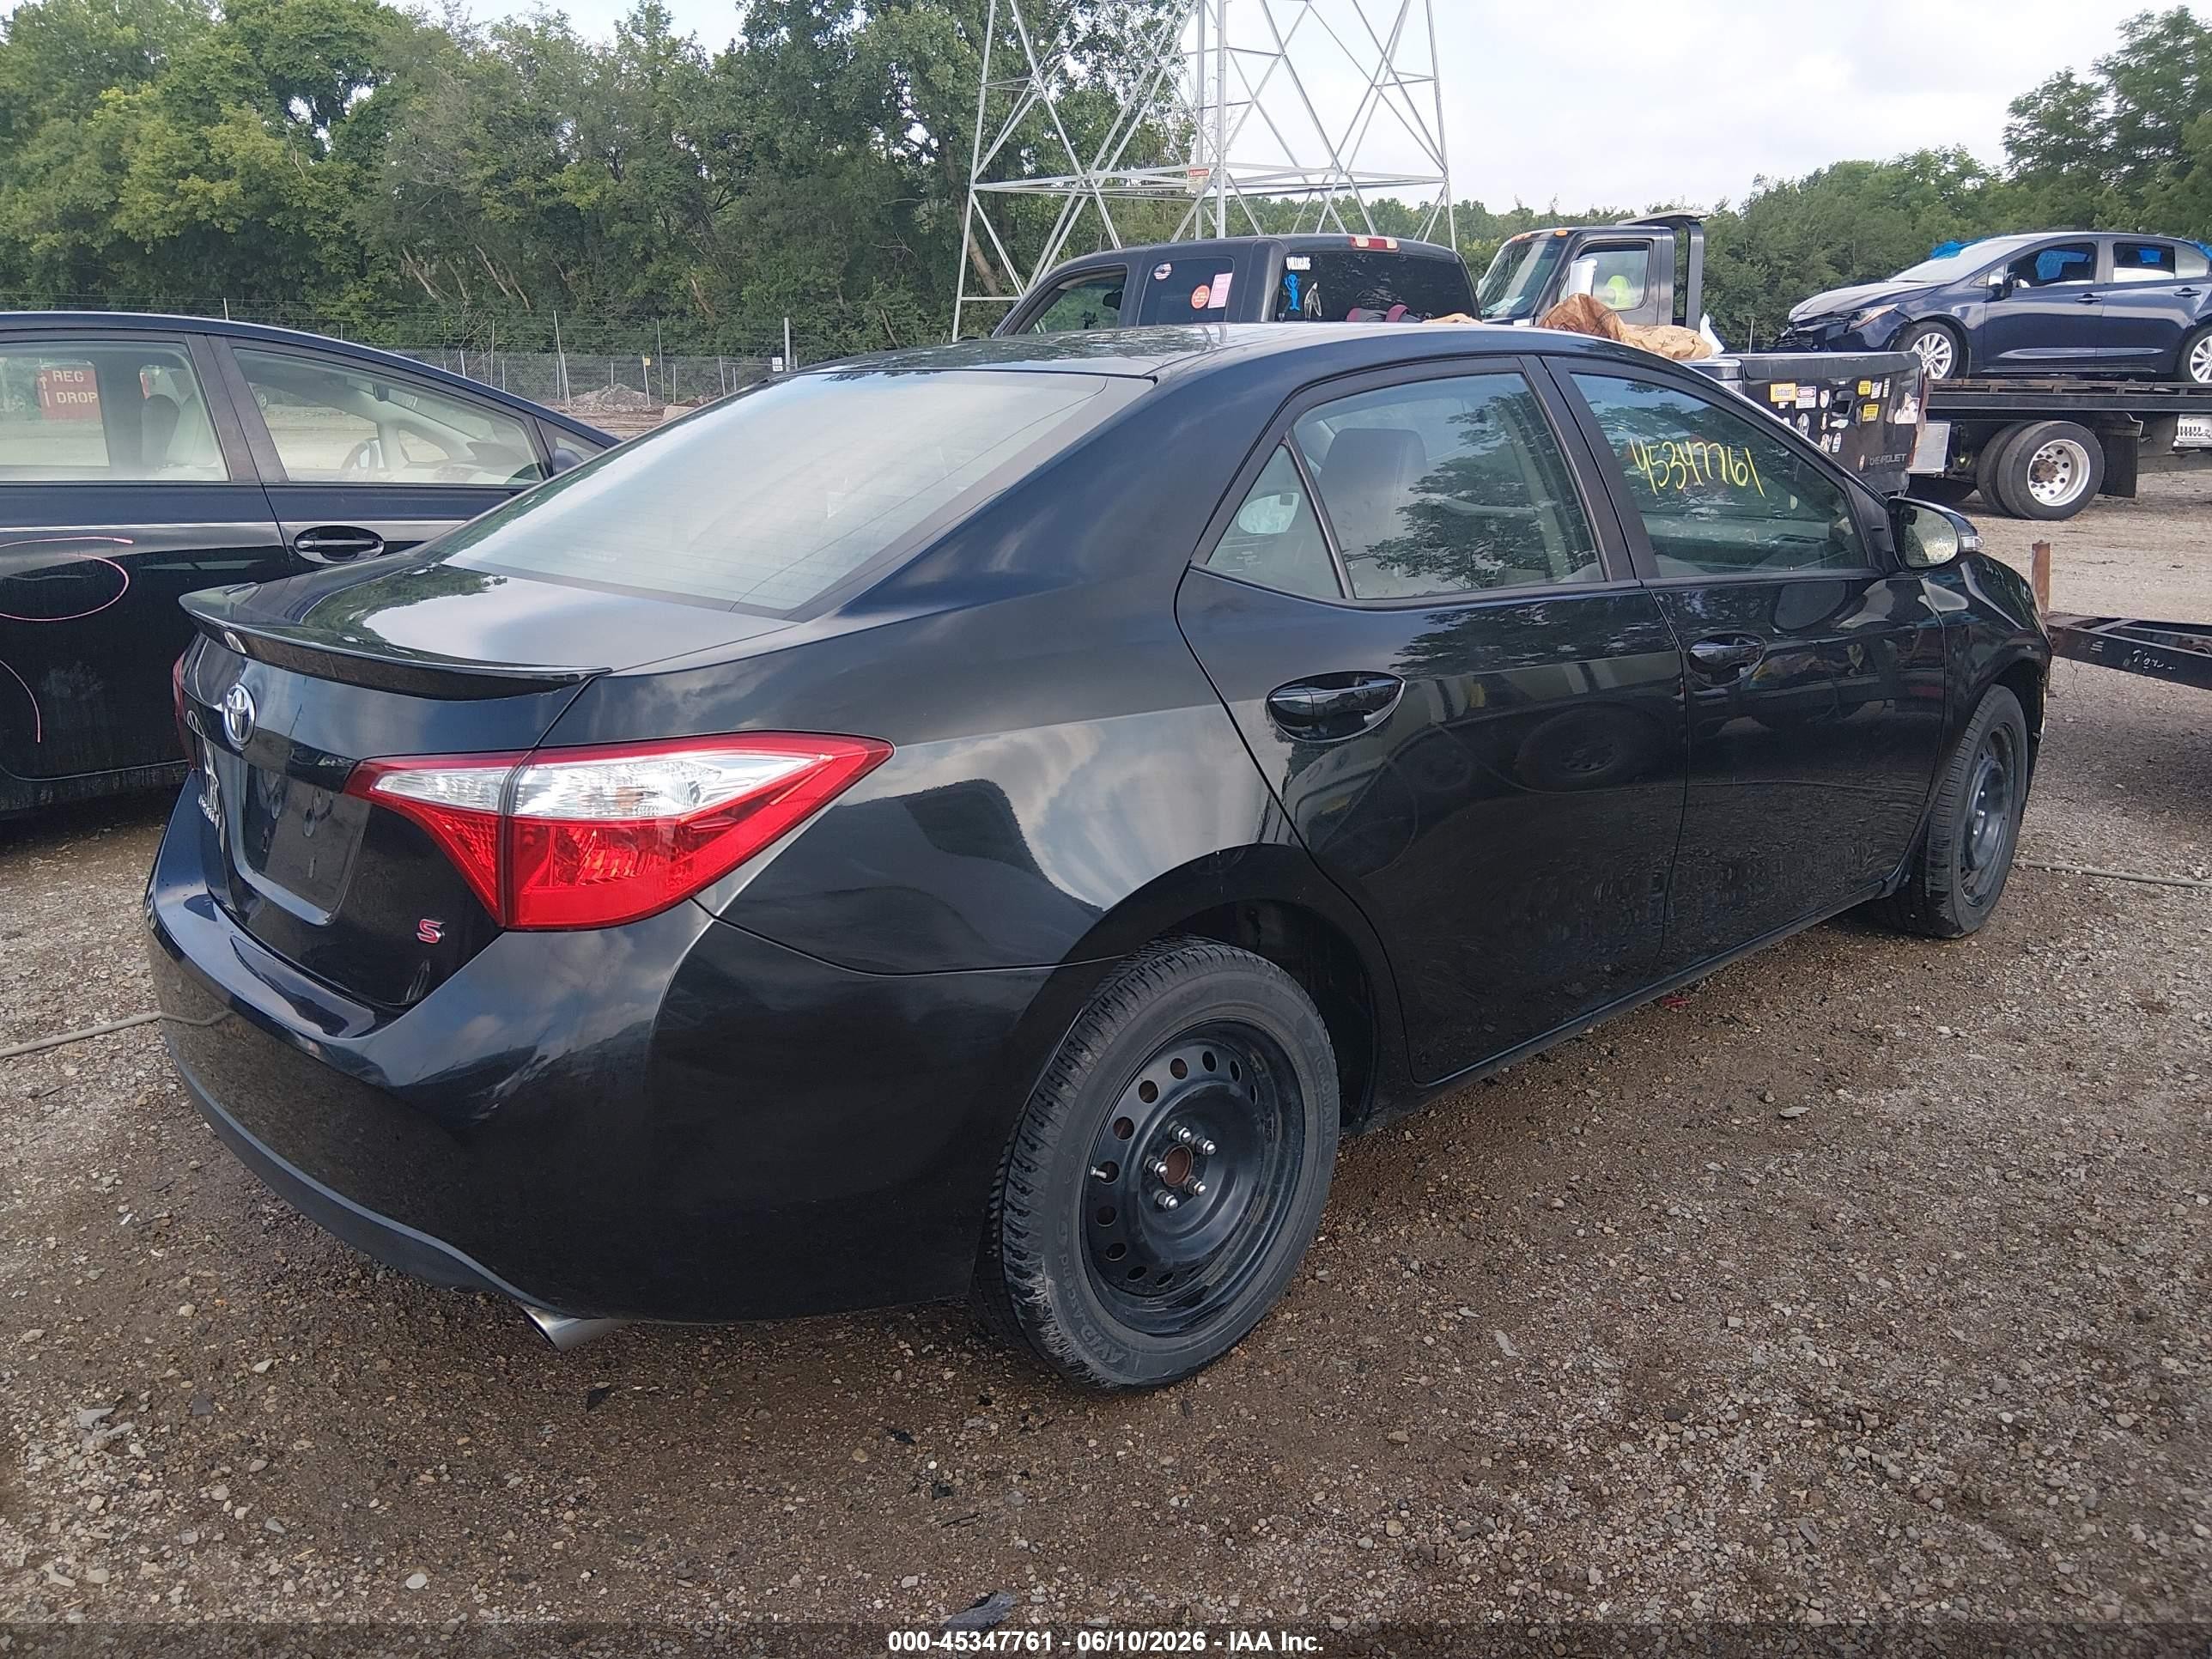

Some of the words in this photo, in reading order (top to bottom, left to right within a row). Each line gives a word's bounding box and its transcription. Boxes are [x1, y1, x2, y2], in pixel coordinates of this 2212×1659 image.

[52, 370, 84, 383] REG
[56, 392, 98, 404] DROP
[1630, 438, 1765, 498] 45347761
[416, 919, 443, 944] S
